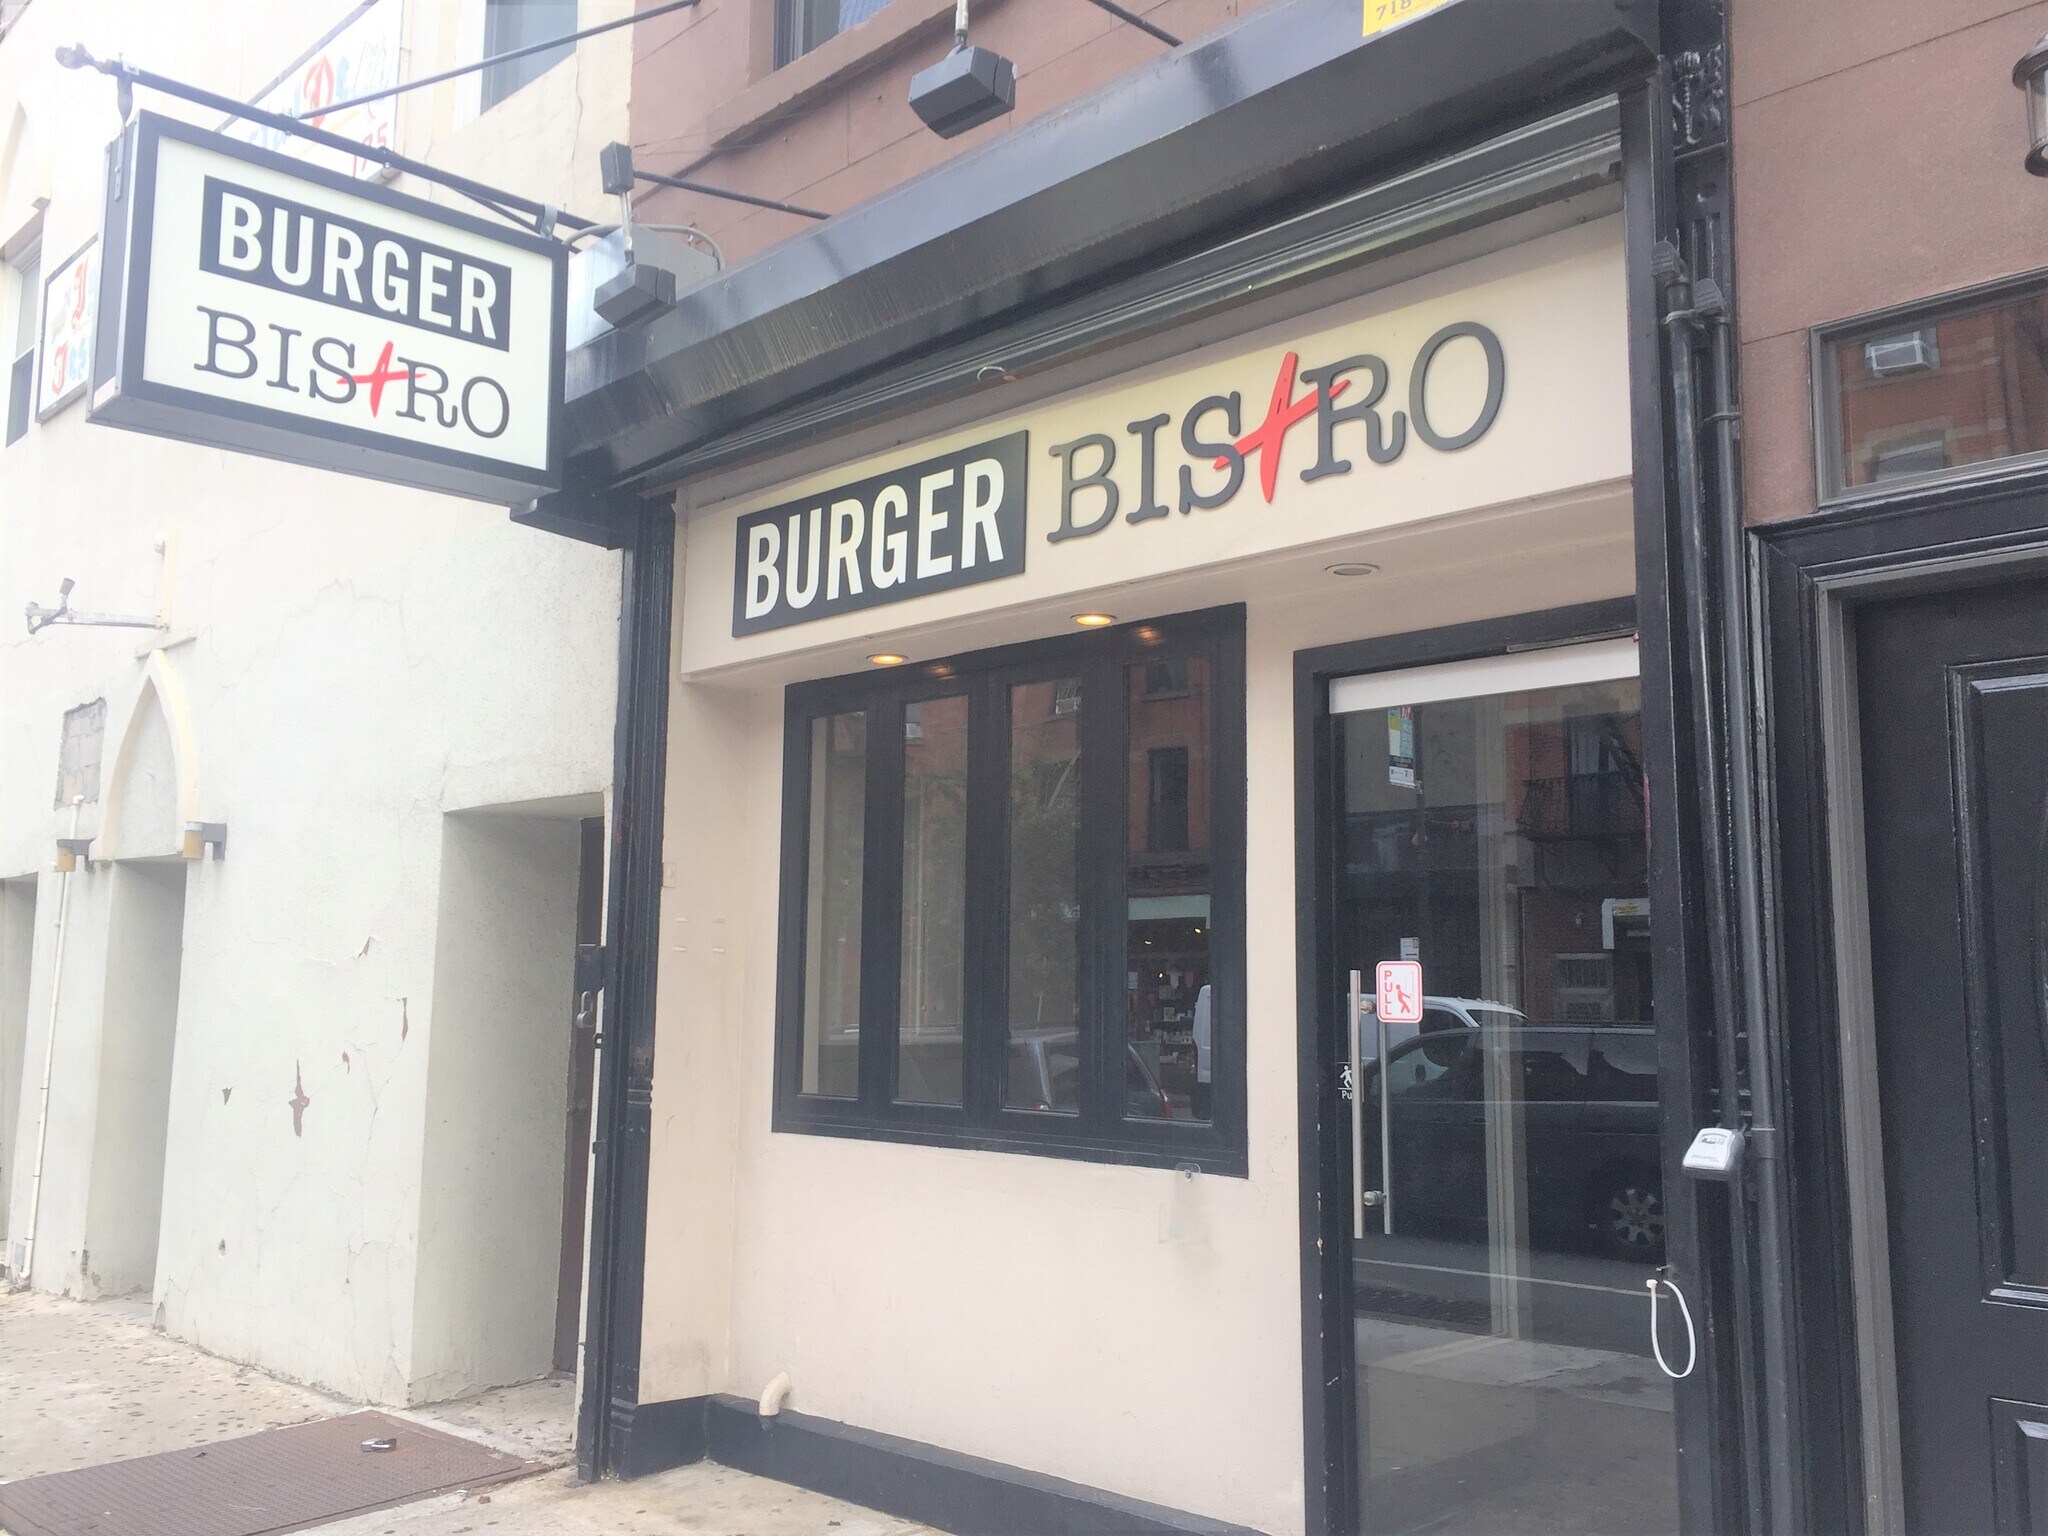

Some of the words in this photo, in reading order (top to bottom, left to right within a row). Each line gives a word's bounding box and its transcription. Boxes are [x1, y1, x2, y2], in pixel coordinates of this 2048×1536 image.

[218, 190, 498, 341] BURGER
[194, 305, 510, 439] BISTRO
[744, 457, 1005, 620] BURGER
[1047, 320, 1507, 545] BISTRO
[1384, 970, 1393, 1016] PULL
